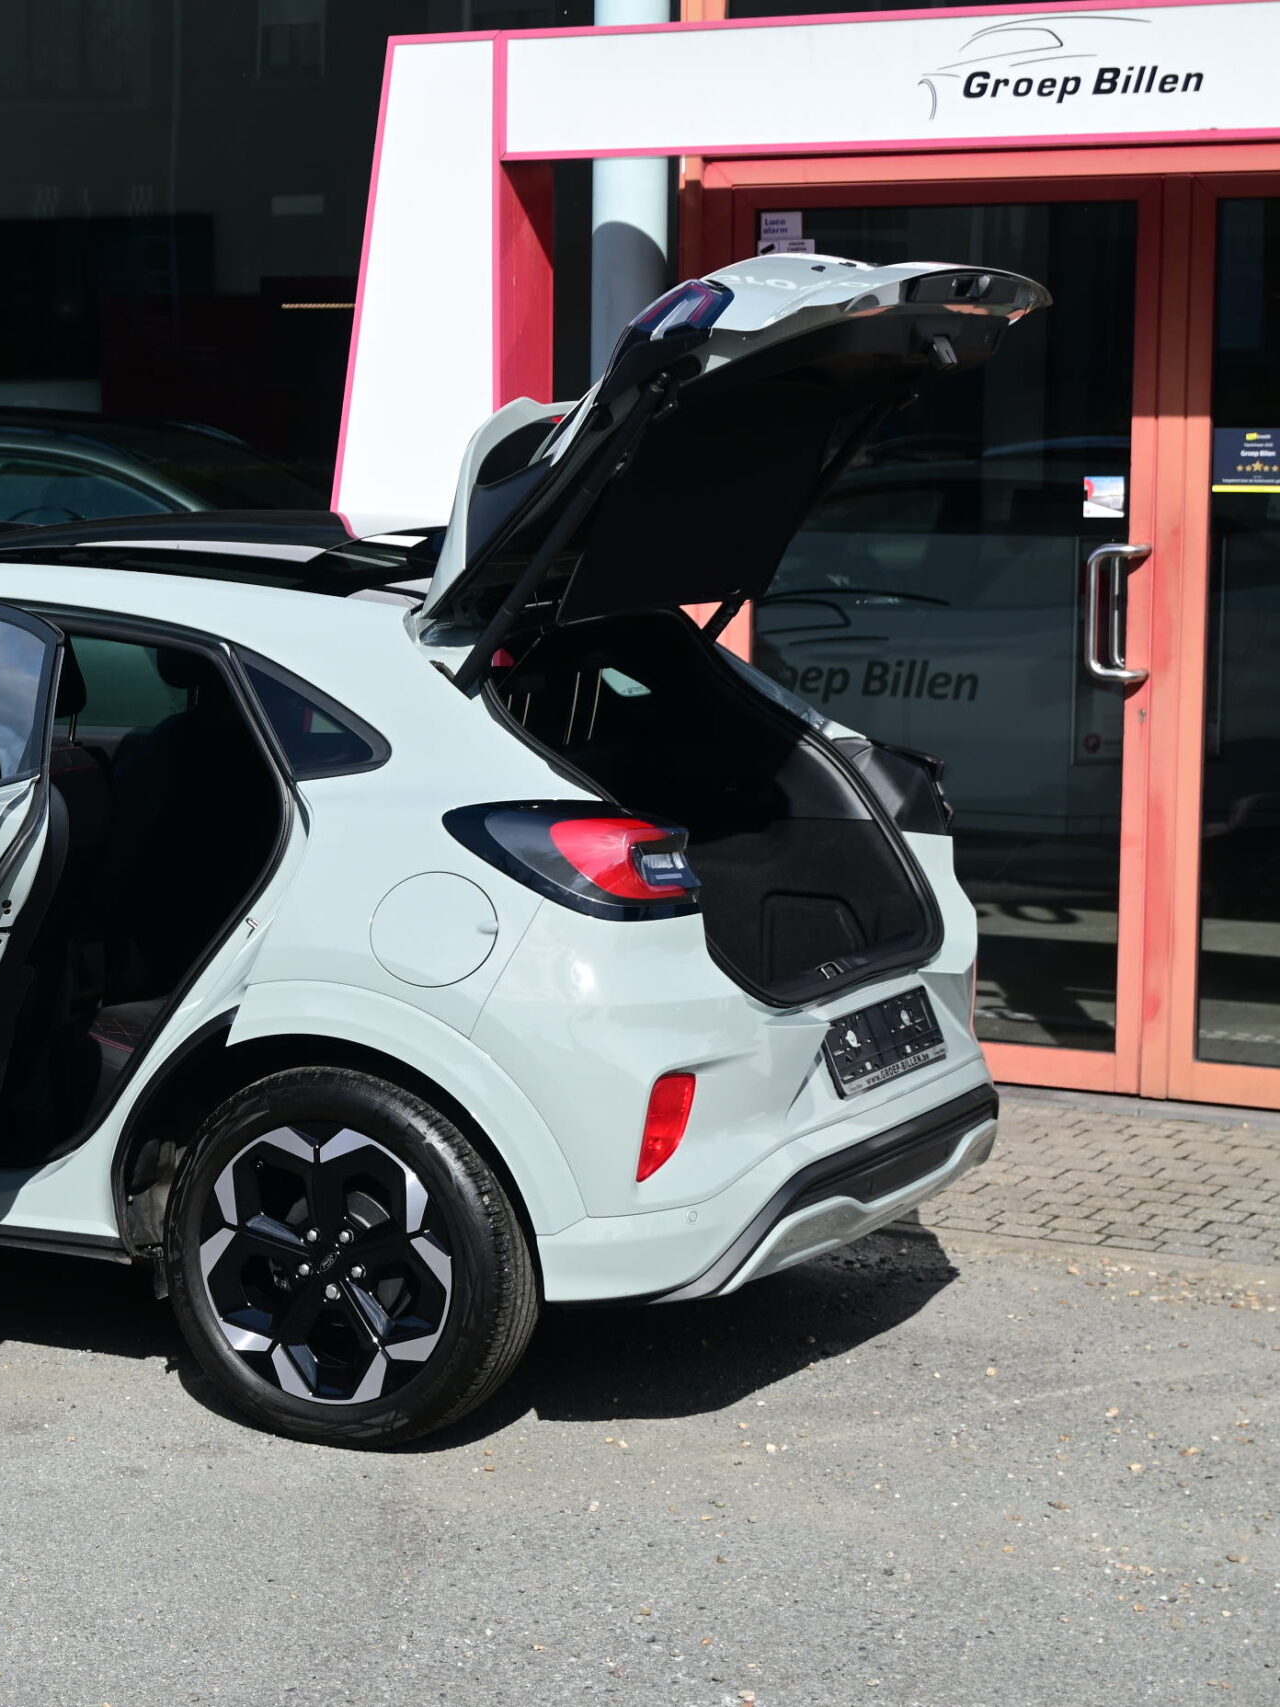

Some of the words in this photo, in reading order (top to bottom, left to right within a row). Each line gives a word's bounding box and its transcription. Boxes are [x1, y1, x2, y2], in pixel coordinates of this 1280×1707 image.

[963, 71, 1082, 104] Groep
[1091, 65, 1204, 95] Billen
[783, 664, 851, 704] oep
[861, 659, 980, 702] Billen
